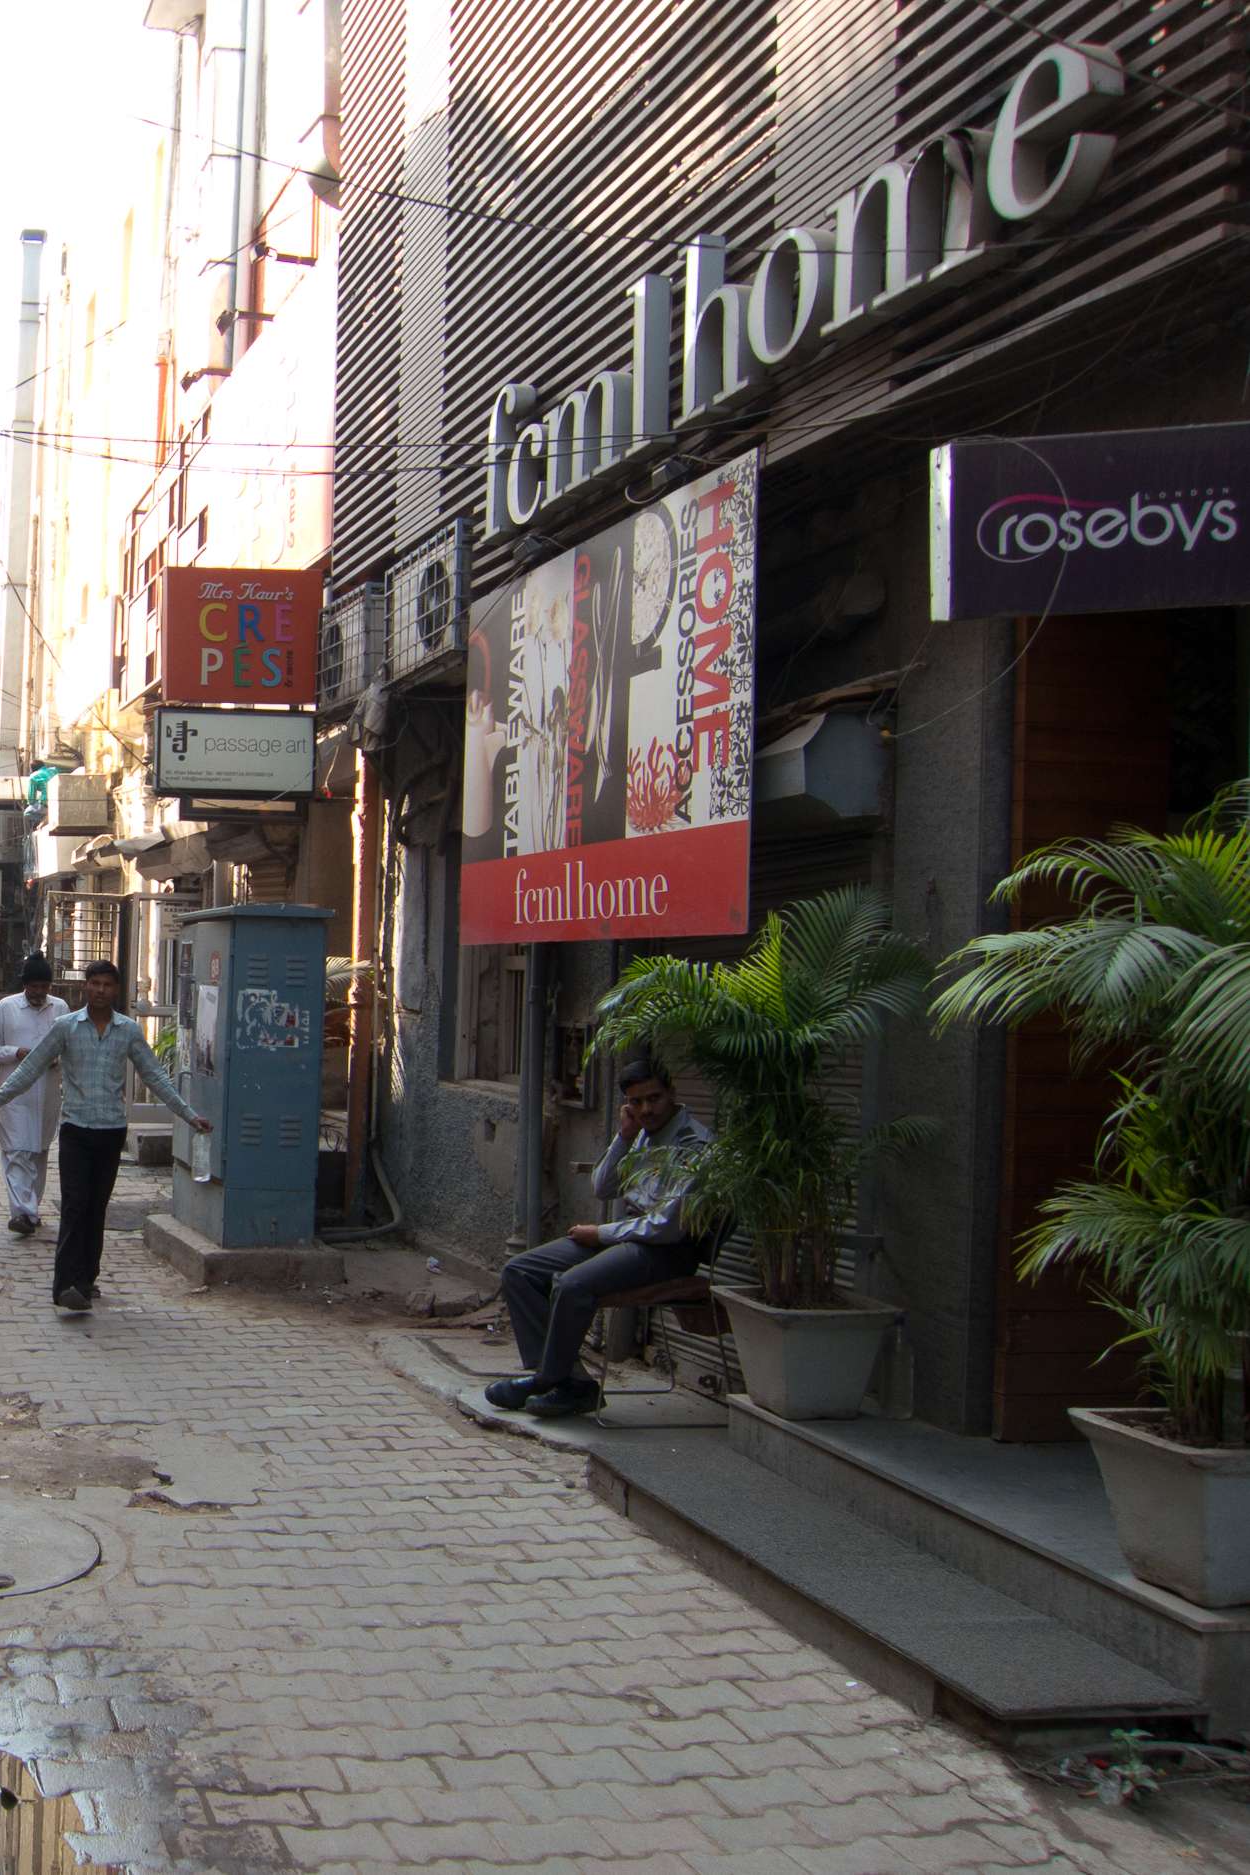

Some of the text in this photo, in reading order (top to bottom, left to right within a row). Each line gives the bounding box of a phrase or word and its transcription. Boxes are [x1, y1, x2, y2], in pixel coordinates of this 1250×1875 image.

[999, 491, 1238, 556] rosebys
[1144, 486, 1230, 501] LONDON
[197, 582, 295, 601] Mrs Kaur's
[673, 497, 701, 826] ACCESSORIES
[691, 478, 738, 774] HOME
[204, 736, 308, 757] passage art
[502, 586, 528, 859] TABLEWARE
[563, 552, 593, 850] GLASSWARE
